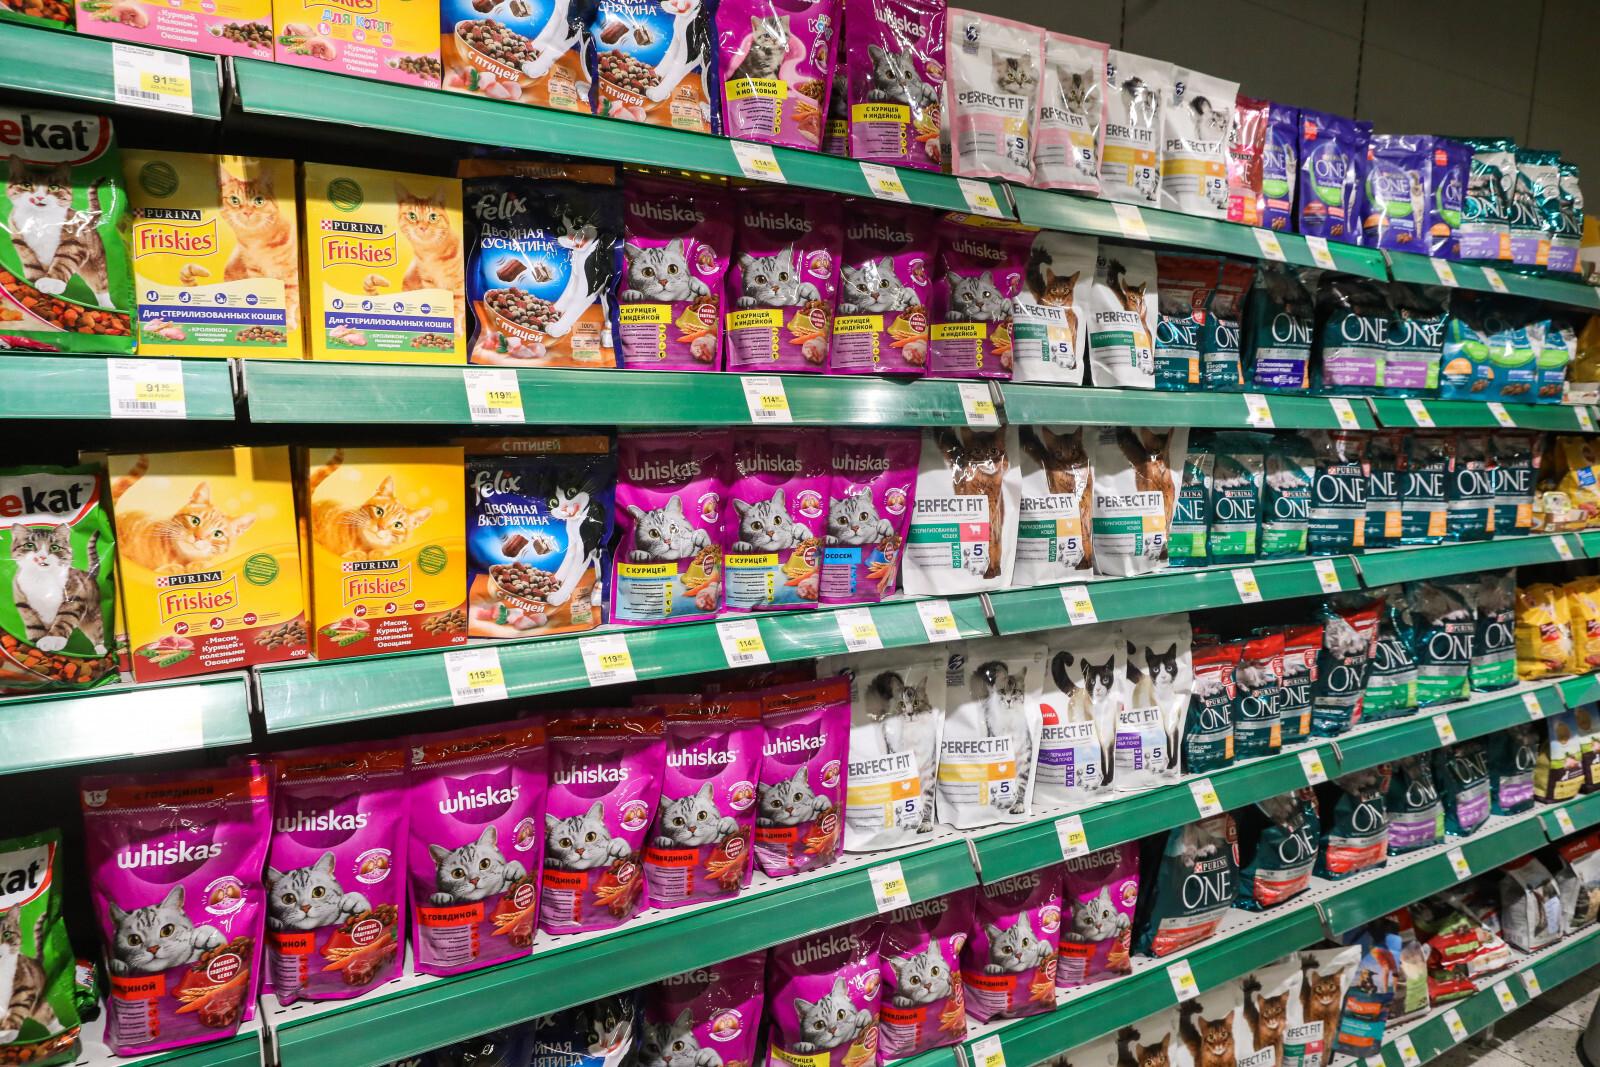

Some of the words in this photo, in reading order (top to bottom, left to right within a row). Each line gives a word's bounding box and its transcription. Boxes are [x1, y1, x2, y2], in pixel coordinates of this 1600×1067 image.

[475, 54, 520, 83] птицей
[606, 84, 645, 107] птицей
[1008, 98, 1024, 110] FIT
[1016, 137, 1024, 149] 5
[1083, 149, 1091, 160] 5
[1143, 168, 1150, 179] 5
[1214, 179, 1221, 189] 5
[471, 192, 527, 221] felix
[630, 202, 705, 223] whiskas
[147, 208, 200, 220] PURINA
[333, 221, 383, 233] PURINA
[744, 212, 813, 233] whiskas
[480, 222, 544, 240] ДВОЙНАЯ
[847, 223, 914, 244] whiskas
[140, 228, 212, 251] Friskies
[328, 240, 392, 263] Friskies
[952, 239, 1008, 261] whiskas
[143, 309, 160, 318] Для
[161, 310, 250, 320] СТЕРИЛИЗОВАННЫХ
[251, 313, 283, 321] КОШЕК
[623, 312, 660, 322] ИНДЕЙКОЙ
[626, 306, 657, 316] КУРИЦЕЙ
[742, 311, 770, 320] КУРИЦЕЙ
[1048, 308, 1061, 320] FIT
[329, 317, 344, 325] Для
[345, 317, 424, 328] СТЕРИЛИЗОВАННЫХ
[424, 321, 452, 329] КОШЕК
[739, 317, 773, 327] ИНДЕЙКОЙ
[1341, 313, 1389, 344] ONE
[501, 321, 544, 343] птицей
[1059, 342, 1068, 353] 5
[1142, 349, 1149, 359] 5
[146, 383, 160, 392] 91
[488, 391, 506, 400] 119
[503, 441, 510, 451] С
[512, 439, 561, 451] ПТИЦЕЙ
[742, 454, 803, 473] whiskas
[832, 454, 890, 471] whiskas
[628, 459, 701, 481] whiskas
[470, 469, 521, 506] felix
[1316, 474, 1367, 503] ONE
[966, 498, 984, 512] FIT
[1061, 496, 1073, 508] FIT
[1097, 495, 1146, 509] PERFECT
[1148, 493, 1161, 505] FIT
[485, 501, 538, 515] ДВОЙНАЯ
[1216, 497, 1256, 519] ONE
[477, 514, 550, 527] ВКУСНЯТИНА
[1067, 538, 1077, 550] 5
[1153, 534, 1162, 545] 5
[973, 543, 983, 556] 5
[353, 560, 398, 571] PURINA
[736, 555, 768, 565] КУРИЦЕЙ
[632, 565, 667, 575] КУРИЦЕЙ
[170, 571, 220, 586] PURINA
[348, 575, 406, 598] Friskies
[165, 589, 233, 615] Friskies
[504, 595, 545, 613] птицей
[373, 633, 414, 642] полезными
[376, 626, 408, 636] Курицей
[202, 642, 238, 653] Курицей
[377, 640, 412, 648] Овощами
[738, 639, 752, 648] 114
[200, 649, 246, 660] полезными
[290, 649, 307, 657] 400г
[602, 655, 618, 664] 119
[204, 657, 244, 667] Овощами
[470, 671, 486, 680] 119
[1241, 695, 1280, 717] ONE
[1144, 709, 1159, 721] FIT
[1079, 723, 1093, 736] FIT
[762, 734, 827, 757] whiskas
[941, 738, 994, 755] PERFECT
[995, 738, 1010, 752] FIT
[666, 748, 737, 768] whiskas
[1152, 747, 1162, 758] 5
[849, 754, 894, 778] ERFECT
[895, 754, 911, 770] FIT
[1086, 763, 1095, 775] 5
[554, 763, 629, 785] whiskas
[999, 781, 1010, 793] 5
[438, 785, 520, 815] whiskas
[904, 800, 915, 813] 5
[276, 810, 368, 833] whiskas
[1279, 824, 1319, 864] ONE
[117, 840, 223, 870] whiskas
[1066, 848, 1122, 872] whiskas
[984, 873, 1041, 899] whiskas
[1182, 869, 1233, 909] ONE
[428, 908, 478, 922] ГОВЯДИНОЙ
[791, 932, 861, 967] whiskas
